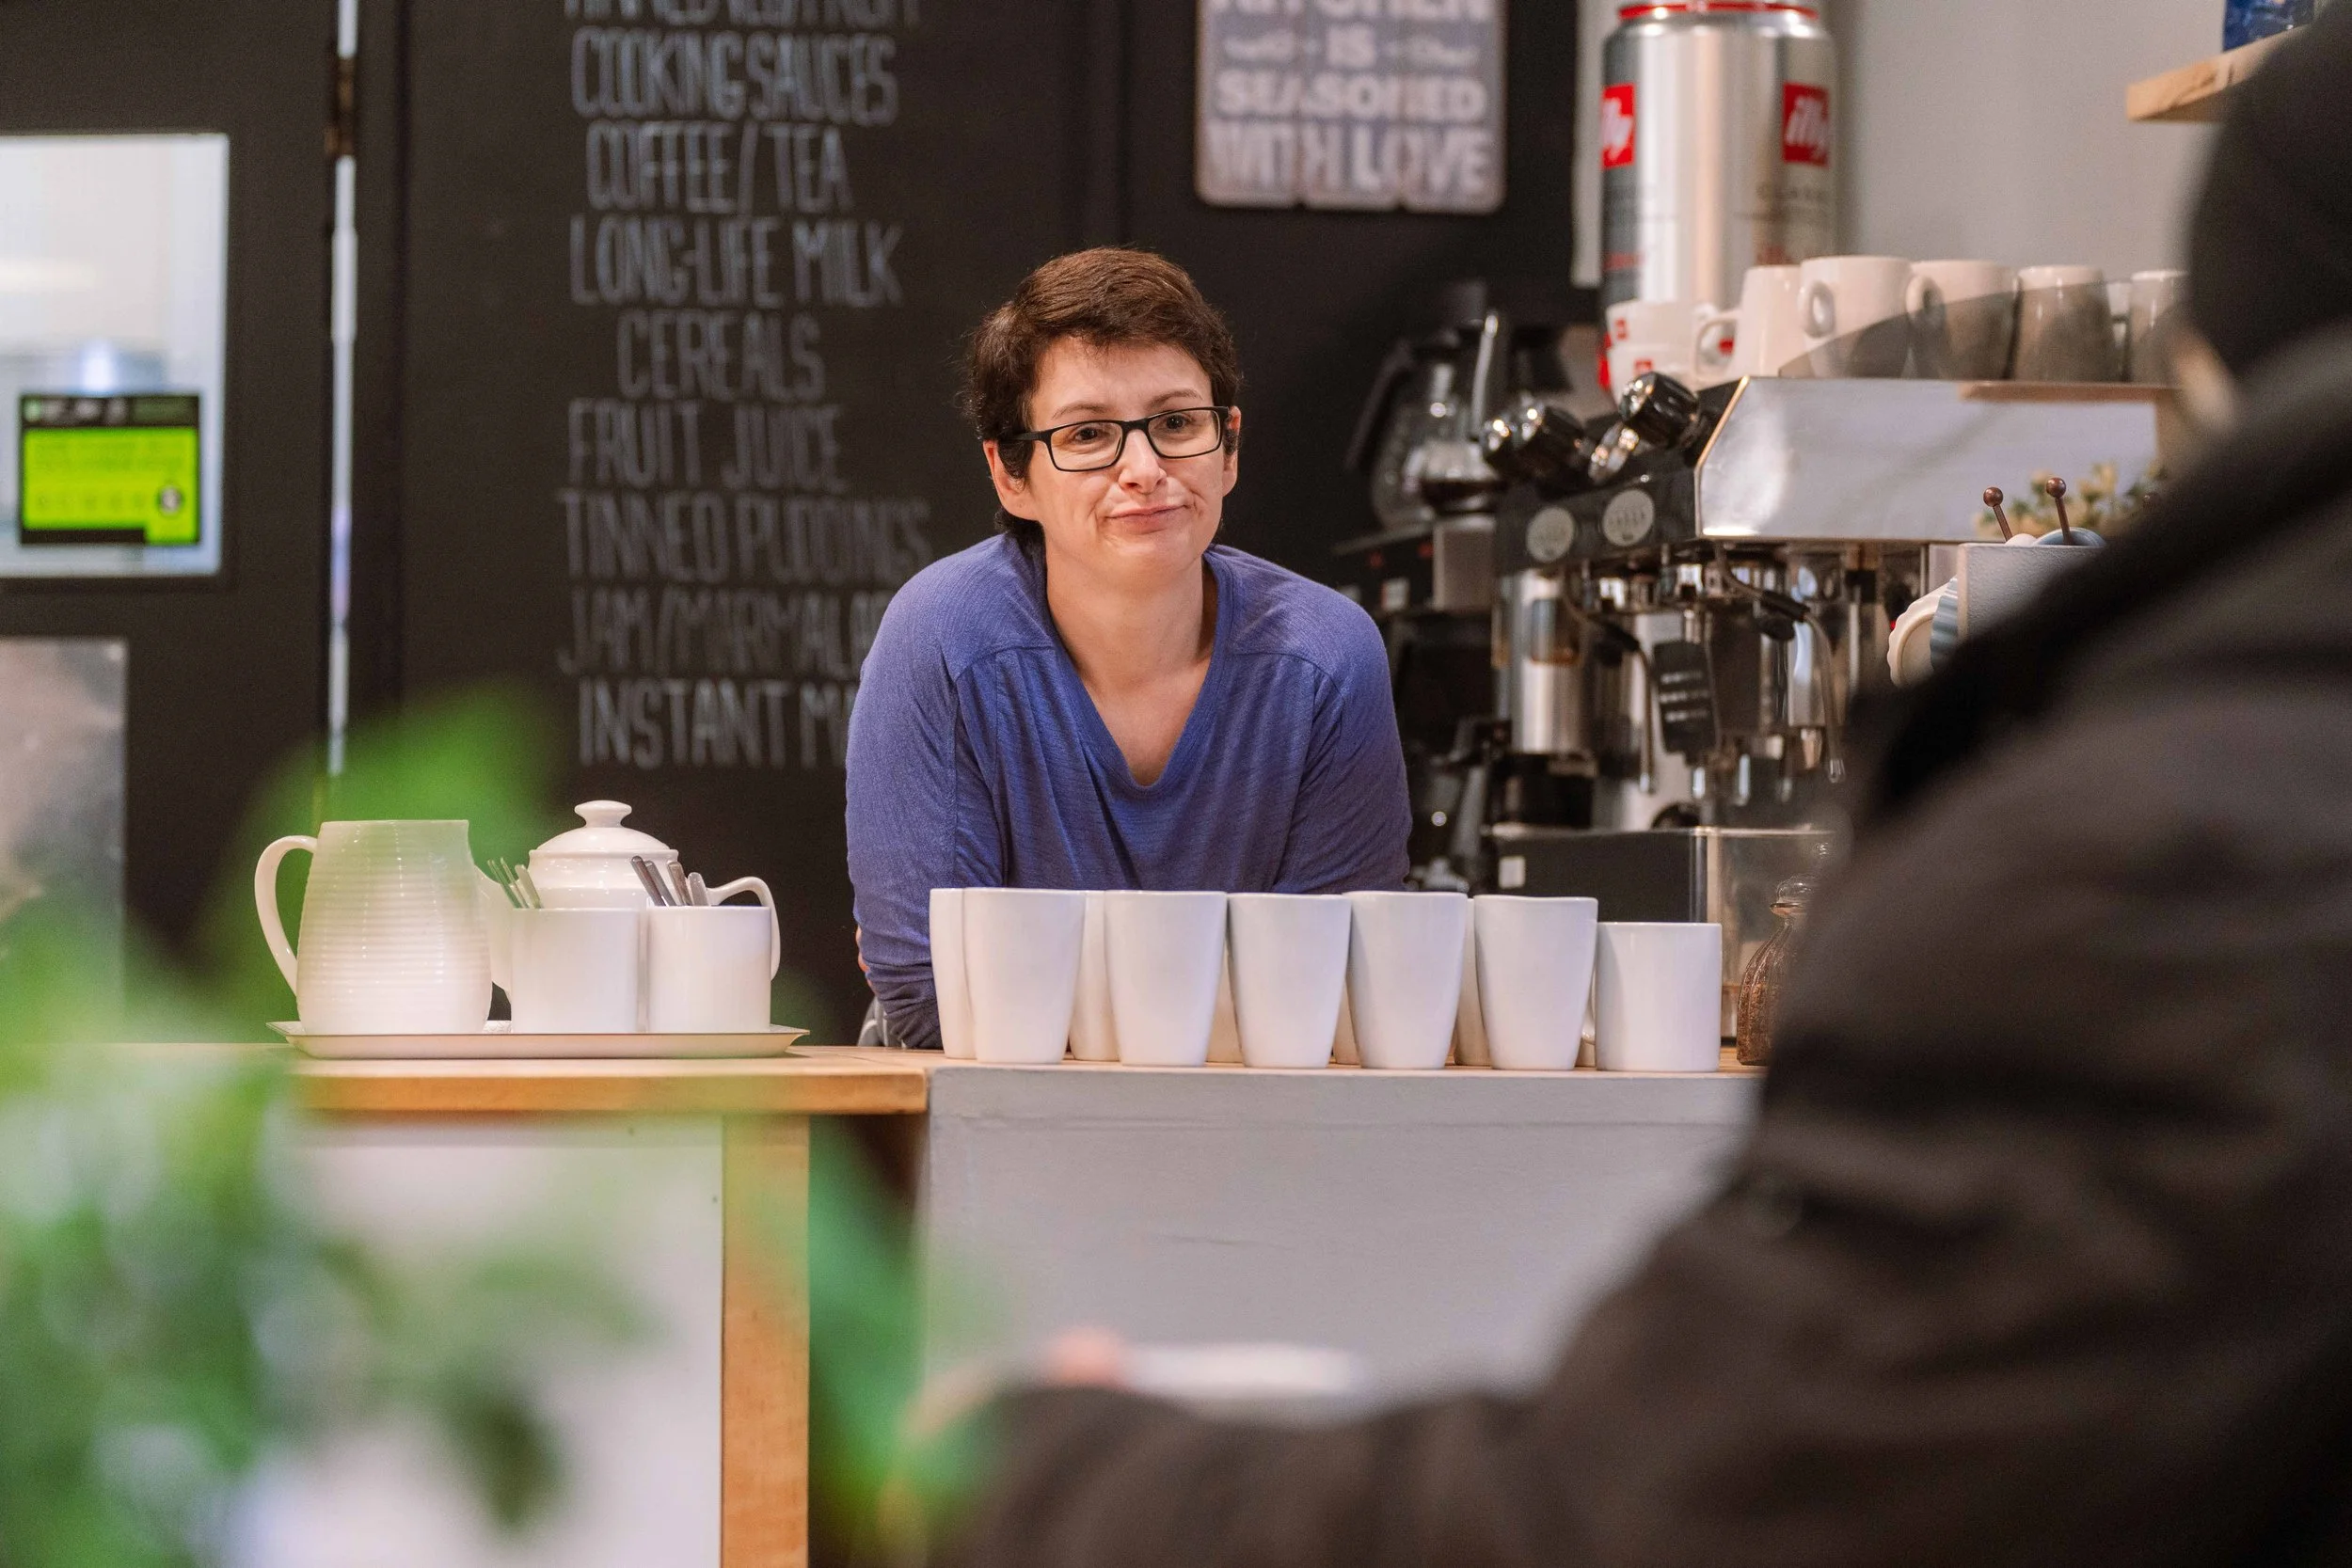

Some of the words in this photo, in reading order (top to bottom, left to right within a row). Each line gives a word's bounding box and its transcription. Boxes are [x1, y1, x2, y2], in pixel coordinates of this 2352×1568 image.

[571, 27, 745, 120] COOKING
[746, 32, 898, 126] SAUCES
[1216, 69, 1487, 121] SEASONED
[1207, 121, 1343, 190] WITH
[1352, 124, 1494, 194] LOVE
[792, 218, 903, 308] MILK
[617, 308, 825, 402] CEREALS
[568, 397, 700, 488] FRUIT
[721, 402, 847, 494] JUICE
[557, 487, 728, 583] TINNED
[579, 678, 791, 769] INSTANT
